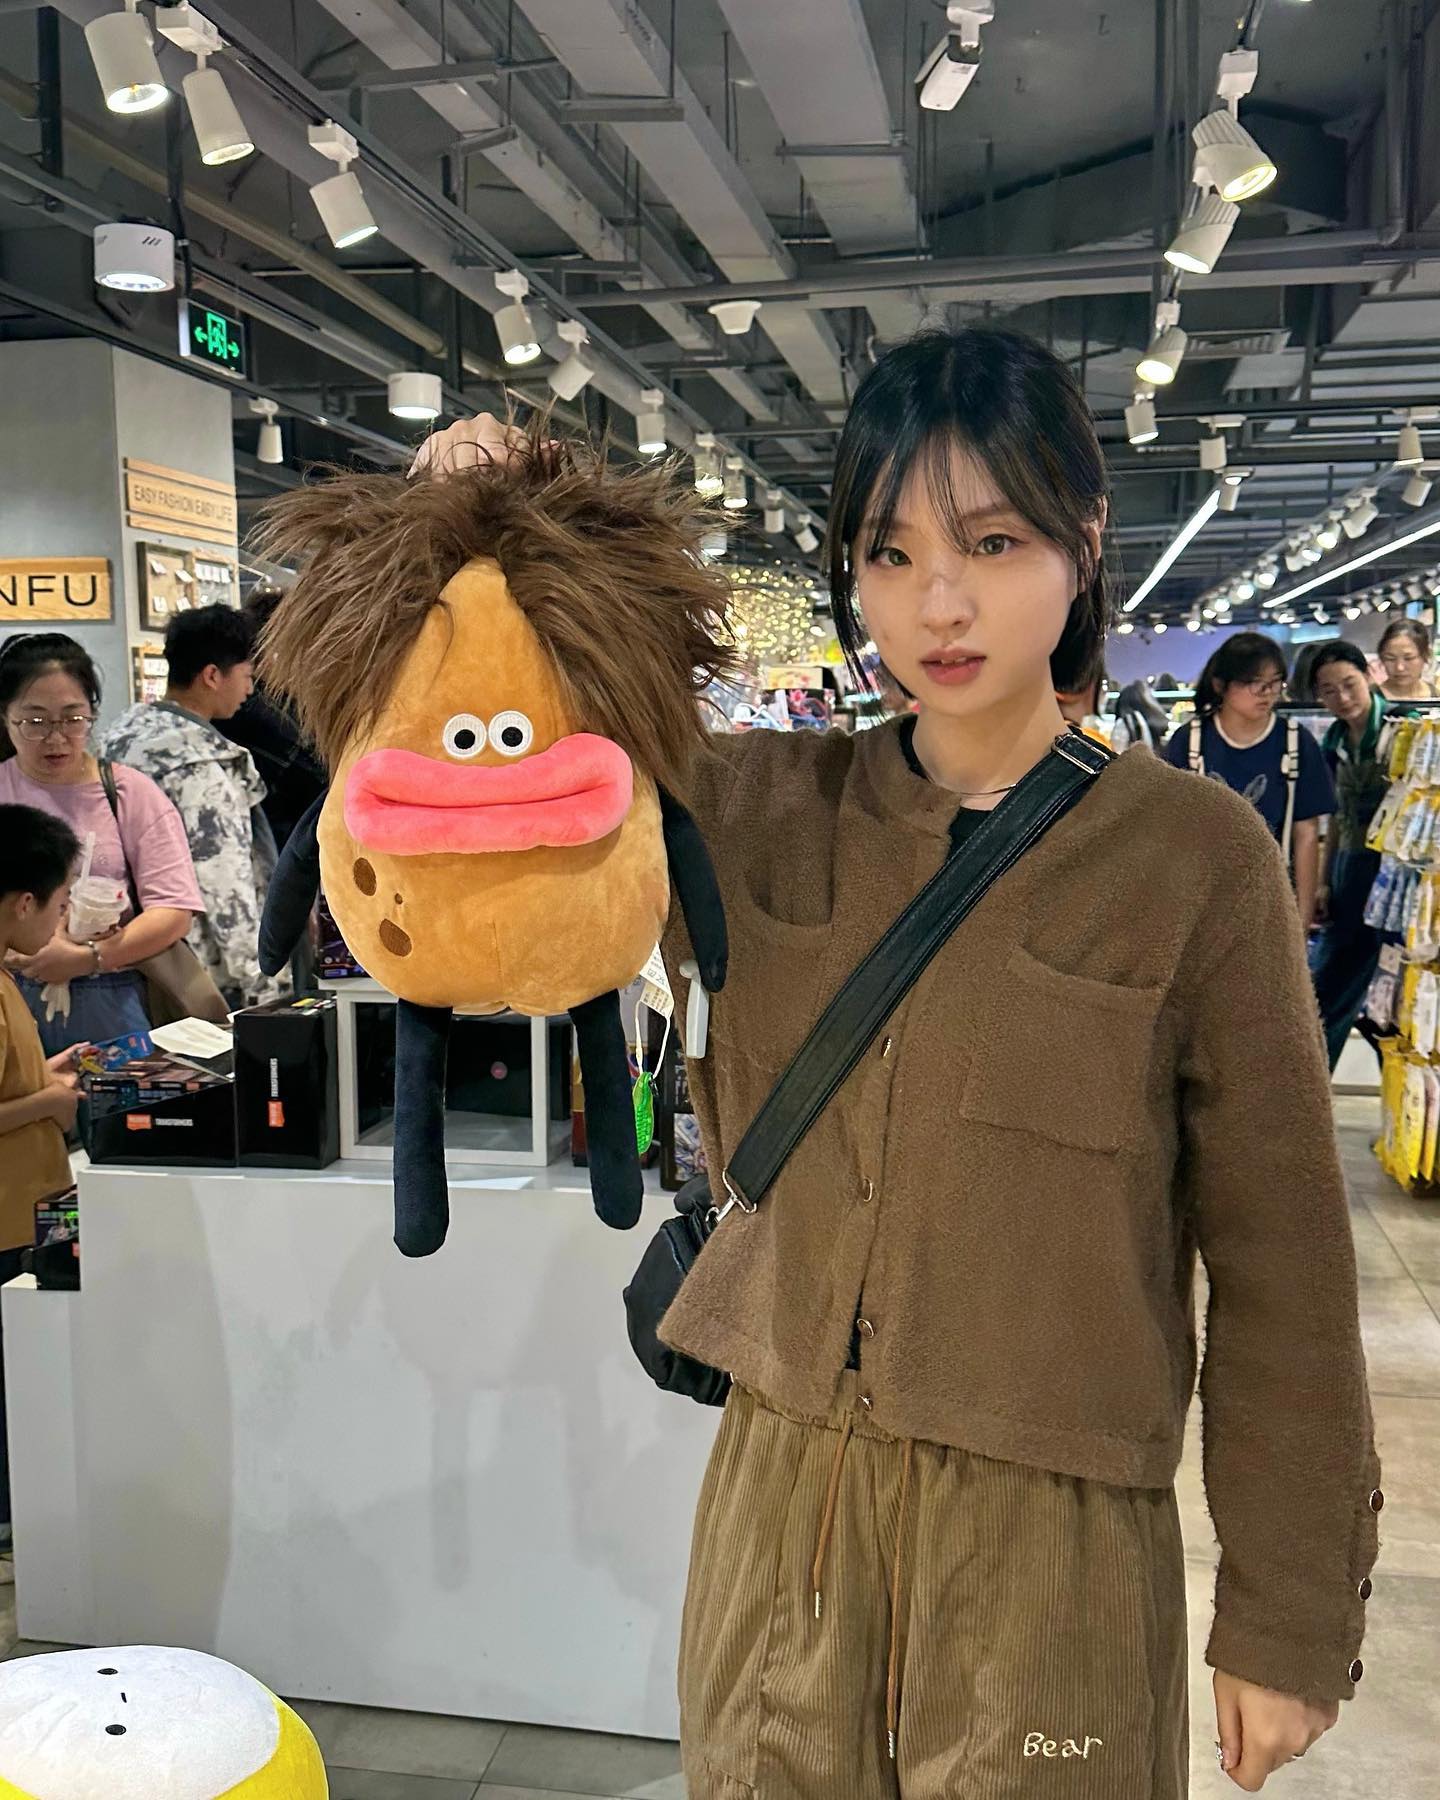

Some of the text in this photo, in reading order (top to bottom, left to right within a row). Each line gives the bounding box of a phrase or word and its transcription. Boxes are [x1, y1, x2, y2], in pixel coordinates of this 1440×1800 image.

[134, 484, 157, 504] EASY
[158, 490, 194, 513] FASHION
[195, 498, 216, 517] EASY
[1023, 1731, 1103, 1759] Bear
